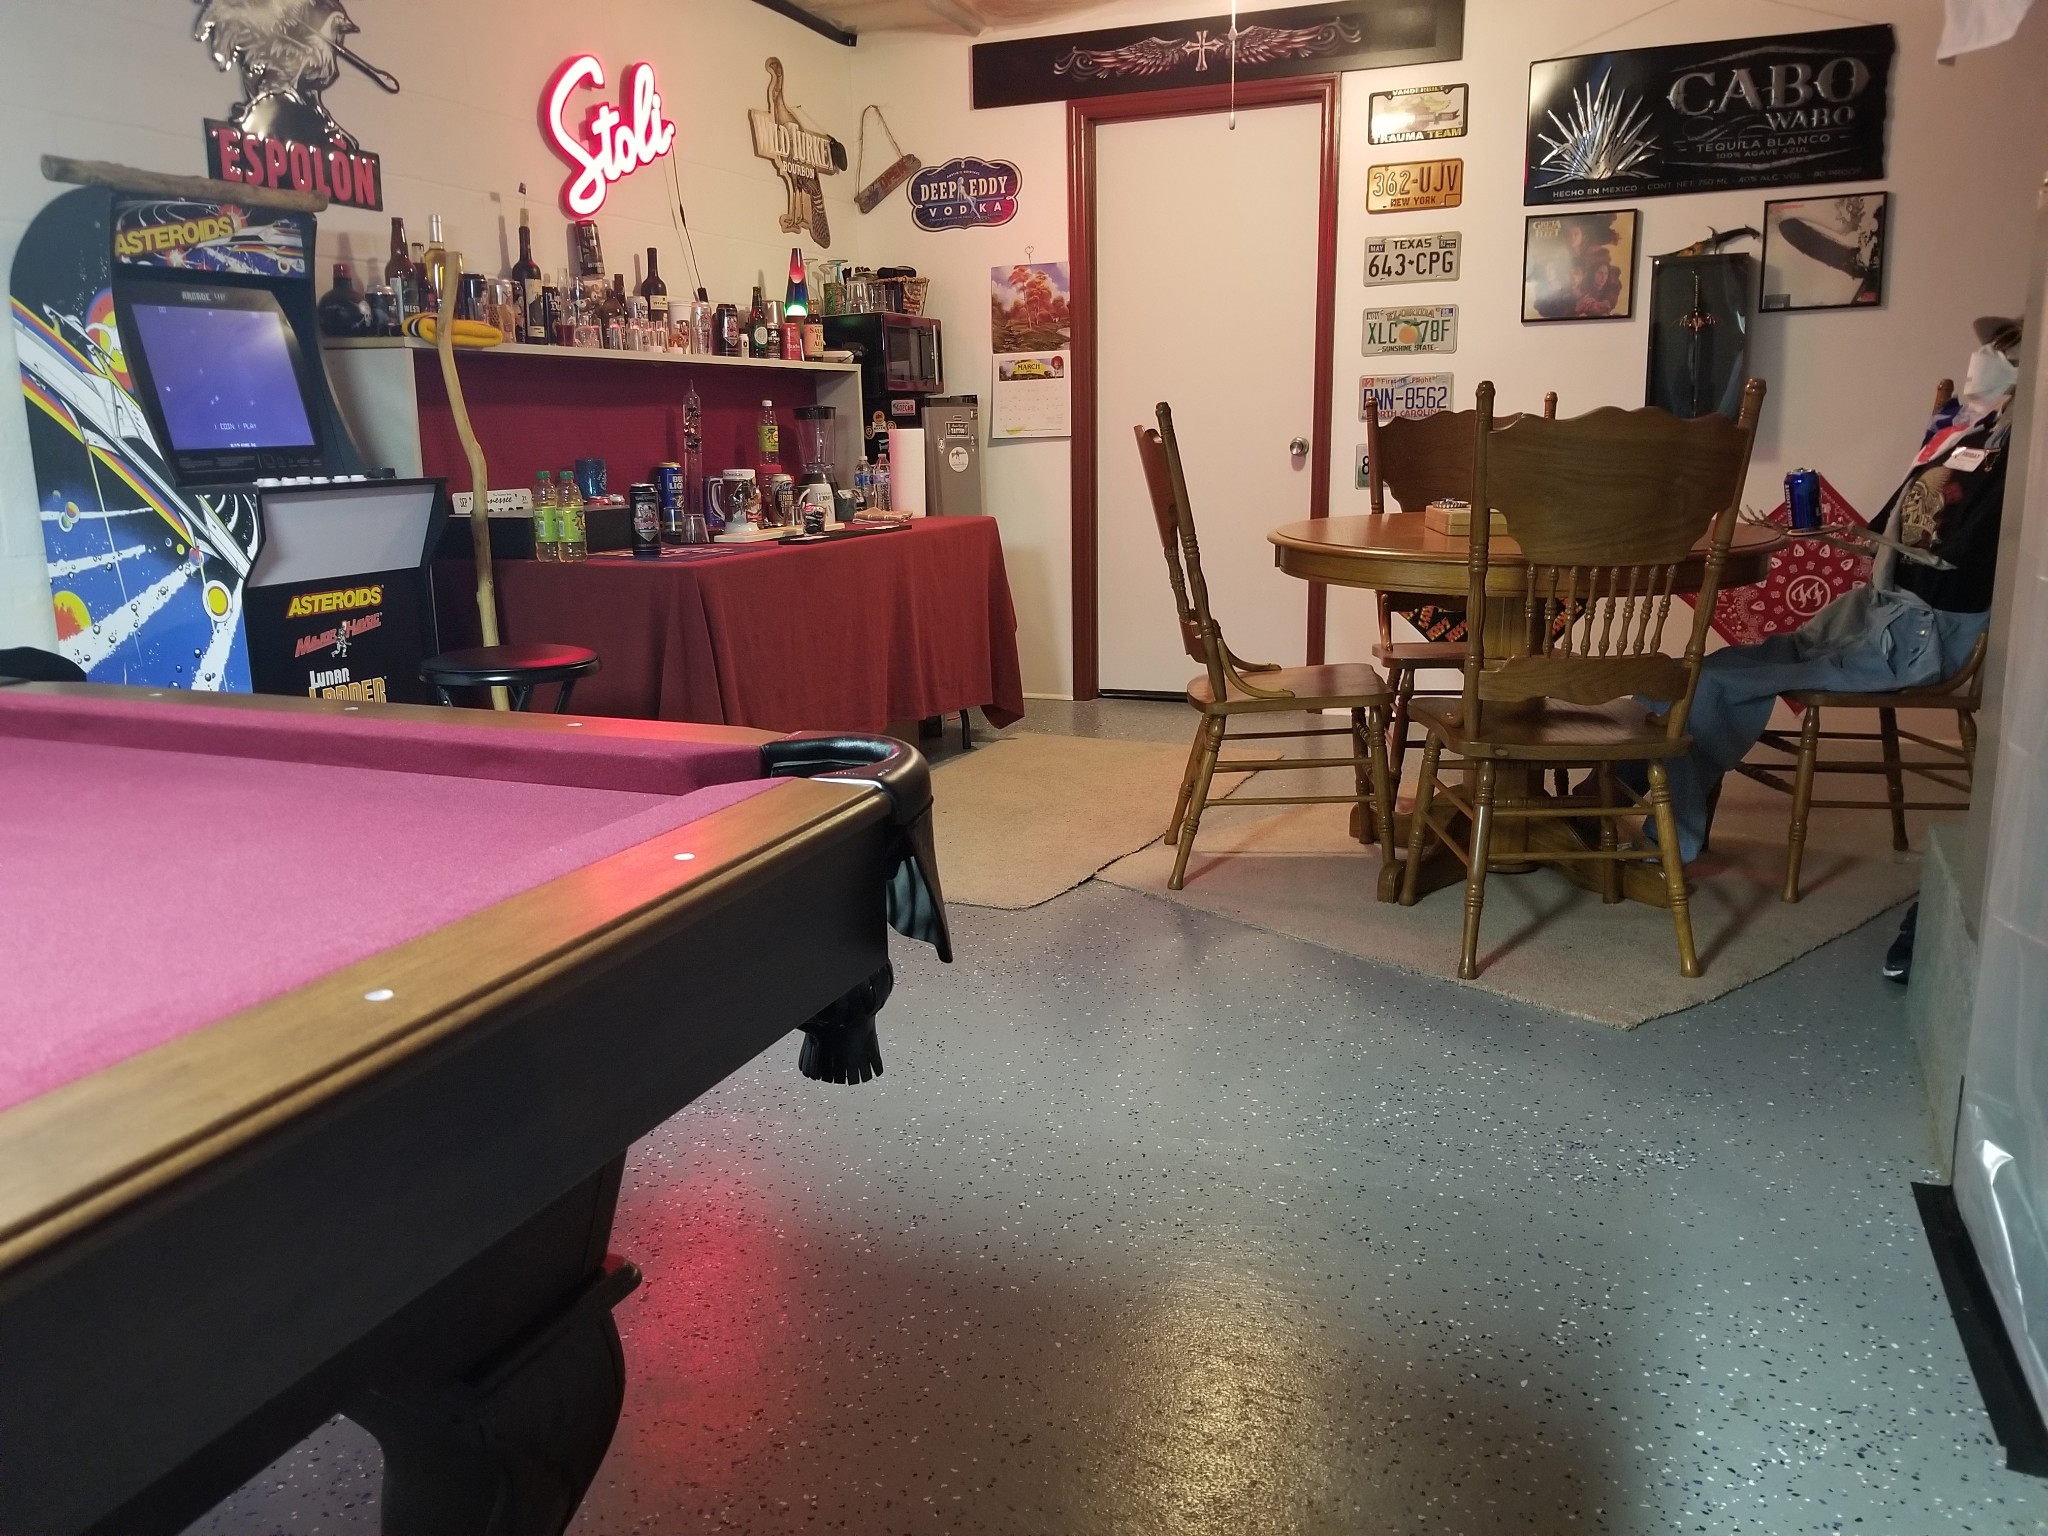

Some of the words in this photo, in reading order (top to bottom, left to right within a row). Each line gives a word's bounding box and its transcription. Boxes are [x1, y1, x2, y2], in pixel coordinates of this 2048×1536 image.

[1667, 57, 1870, 116] CABO
[1766, 106, 1855, 131] WABO
[547, 55, 676, 217] Stoli
[1373, 131, 1424, 144] TRAUMA
[1427, 127, 1461, 139] TEAM
[1698, 139, 1761, 152] TEQUILA
[1767, 134, 1830, 147] BLANCO
[782, 160, 815, 179] BOURBON
[1372, 164, 1458, 197] 362-UJV
[920, 182, 957, 202] DEEP
[969, 176, 1008, 197] EDDY
[1552, 188, 1585, 198] HECHO
[1587, 187, 1600, 195] EN
[1602, 185, 1638, 193] MEXICO
[1390, 197, 1410, 208] NEW
[1413, 195, 1436, 206] YORK
[929, 202, 1002, 218] VODKA
[115, 215, 235, 256] ASTEROIDS
[1370, 244, 1384, 252] MAY
[1393, 238, 1432, 250] TEXAS
[1386, 307, 1434, 320] FLORIDA
[1382, 344, 1412, 352] SUNSHINE
[1414, 343, 1434, 351] STATE
[1017, 363, 1041, 371] MARCH
[1411, 376, 1432, 384] Flight
[1377, 410, 1397, 418] RTH
[243, 422, 257, 430] PLAY
[487, 496, 513, 505] nessee
[287, 586, 381, 617] ASTEROIDS
[309, 667, 350, 689] LUNAR
